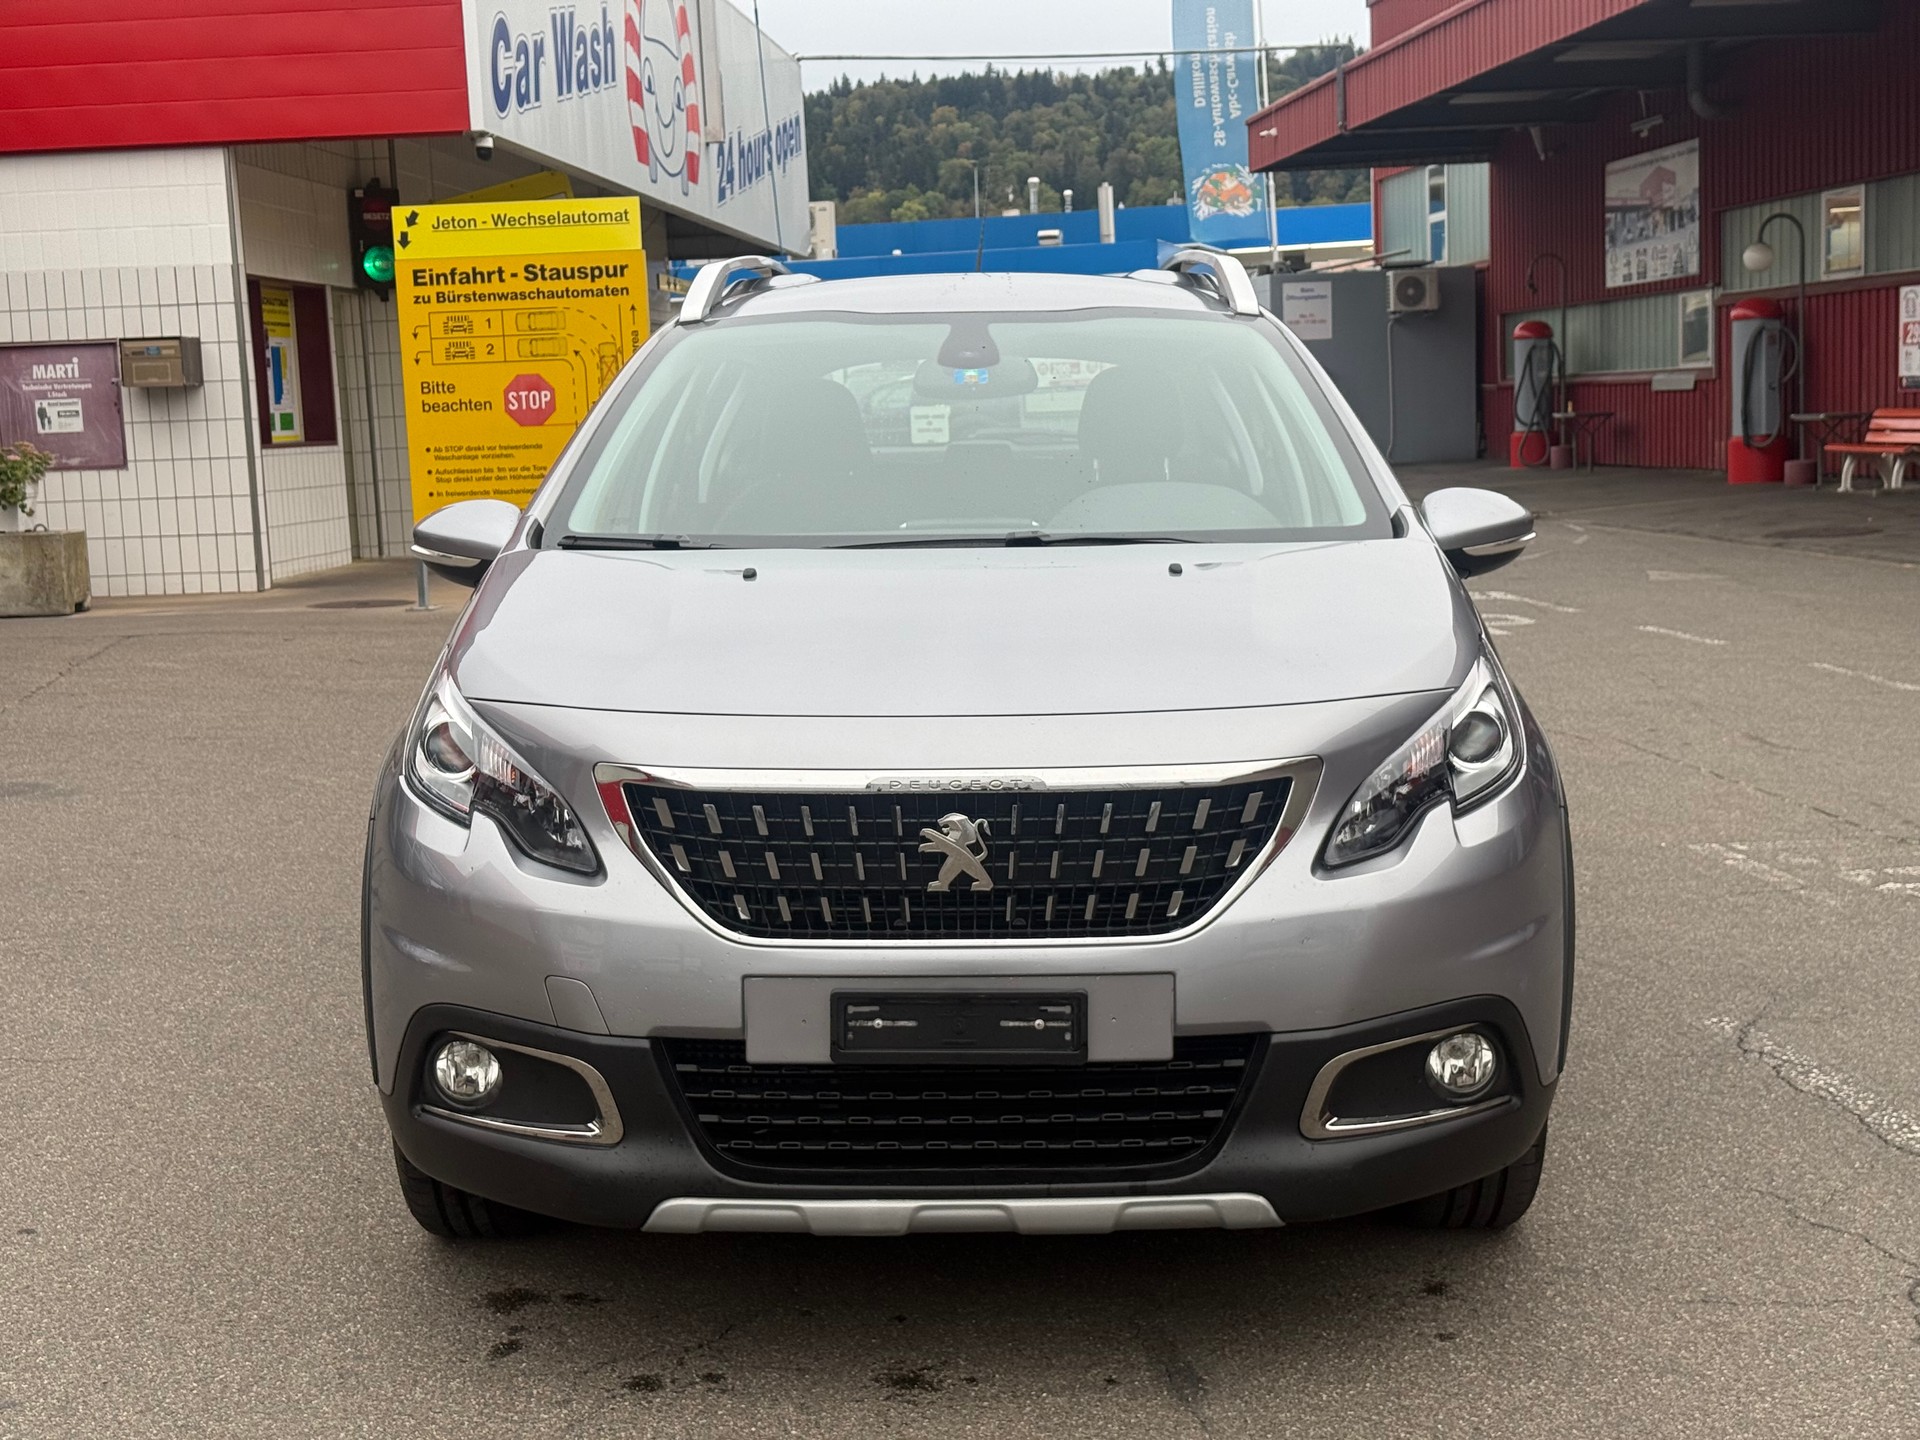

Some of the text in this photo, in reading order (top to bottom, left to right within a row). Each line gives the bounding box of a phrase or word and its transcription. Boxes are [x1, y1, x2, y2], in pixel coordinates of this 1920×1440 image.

[491, 5, 616, 117] Car Wash
[717, 111, 802, 206] 24 hours open
[363, 212, 391, 221] BESETZ
[432, 215, 477, 231] Jeton
[492, 208, 630, 228] Wechselautomat
[412, 265, 506, 287] Einfahrt
[524, 262, 629, 283] Stauspur
[413, 285, 630, 304] zu Bürstenwaschautomaten
[486, 318, 492, 329] 1
[486, 344, 495, 355] 2
[421, 381, 456, 394] Bitte
[422, 400, 493, 413] beachten
[508, 390, 551, 410] STOP
[434, 453, 479, 461] Waschanlage
[436, 476, 453, 484] Stop
[890, 779, 1022, 791] PEUGEOT
